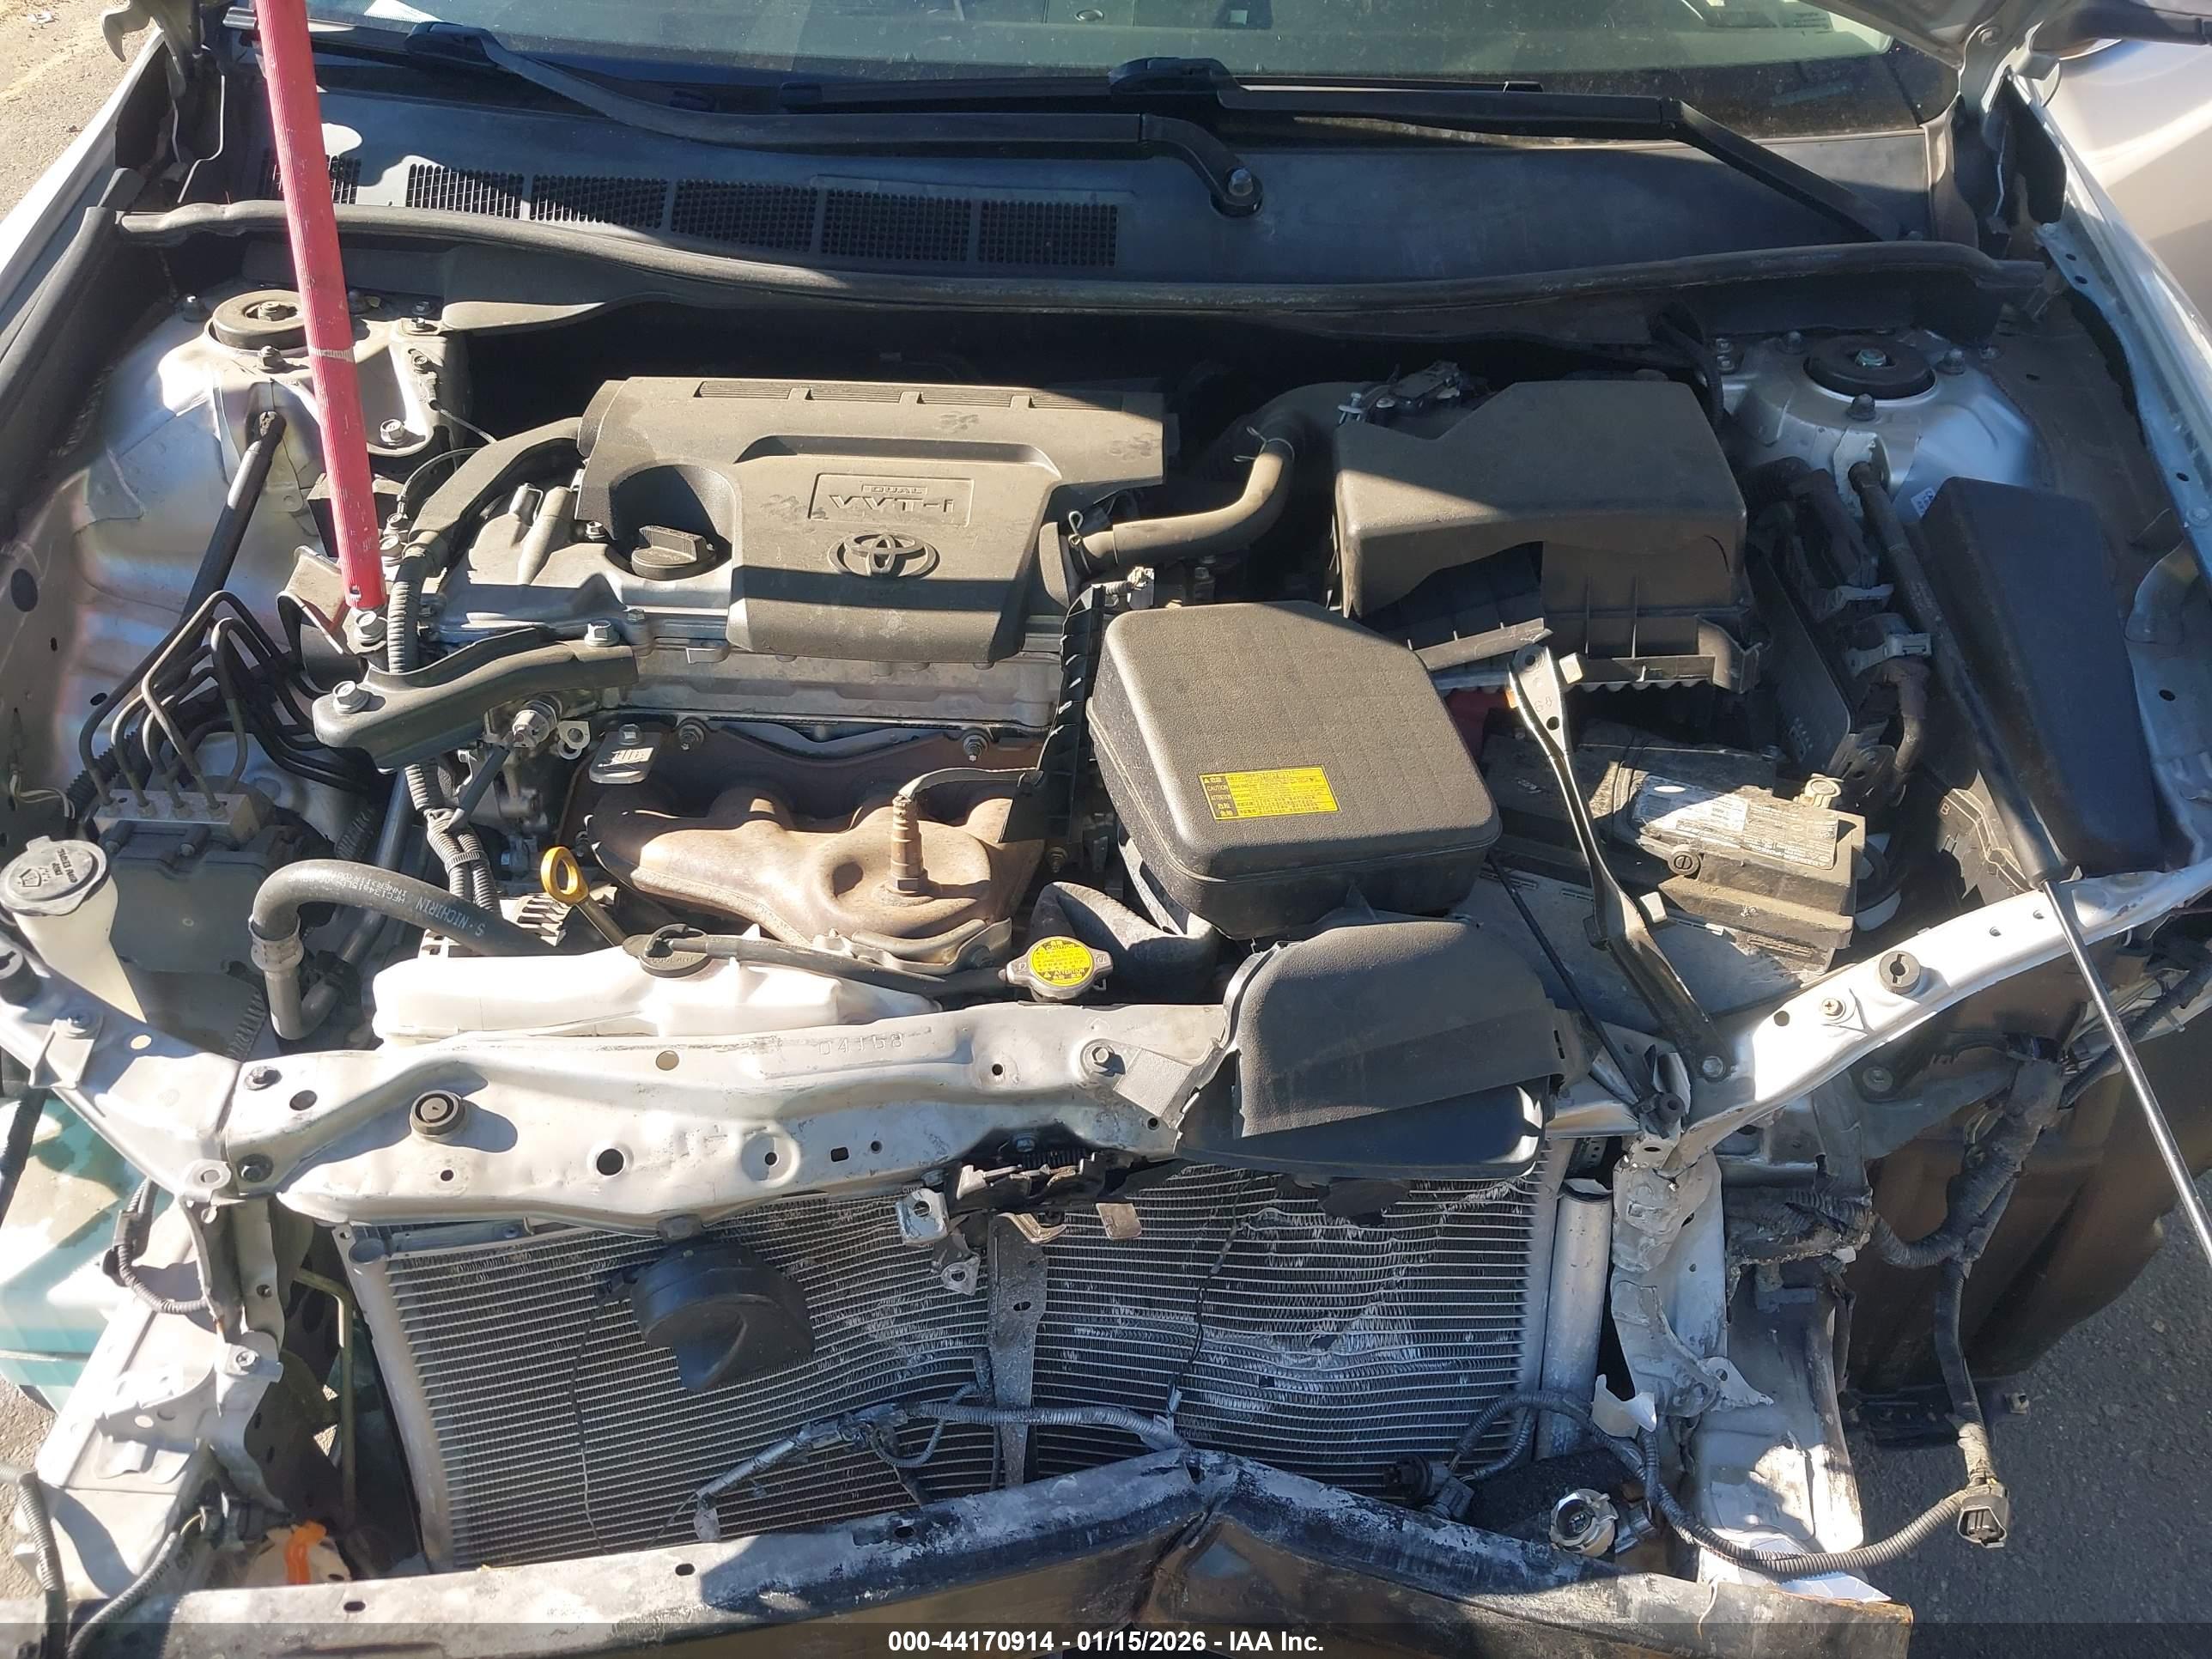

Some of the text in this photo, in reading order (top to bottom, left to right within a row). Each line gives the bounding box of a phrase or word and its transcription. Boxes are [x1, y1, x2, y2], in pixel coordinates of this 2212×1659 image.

[871, 485, 922, 495] DUAL
[829, 494, 955, 514] VVT-i
[1939, 802, 1950, 816] B
